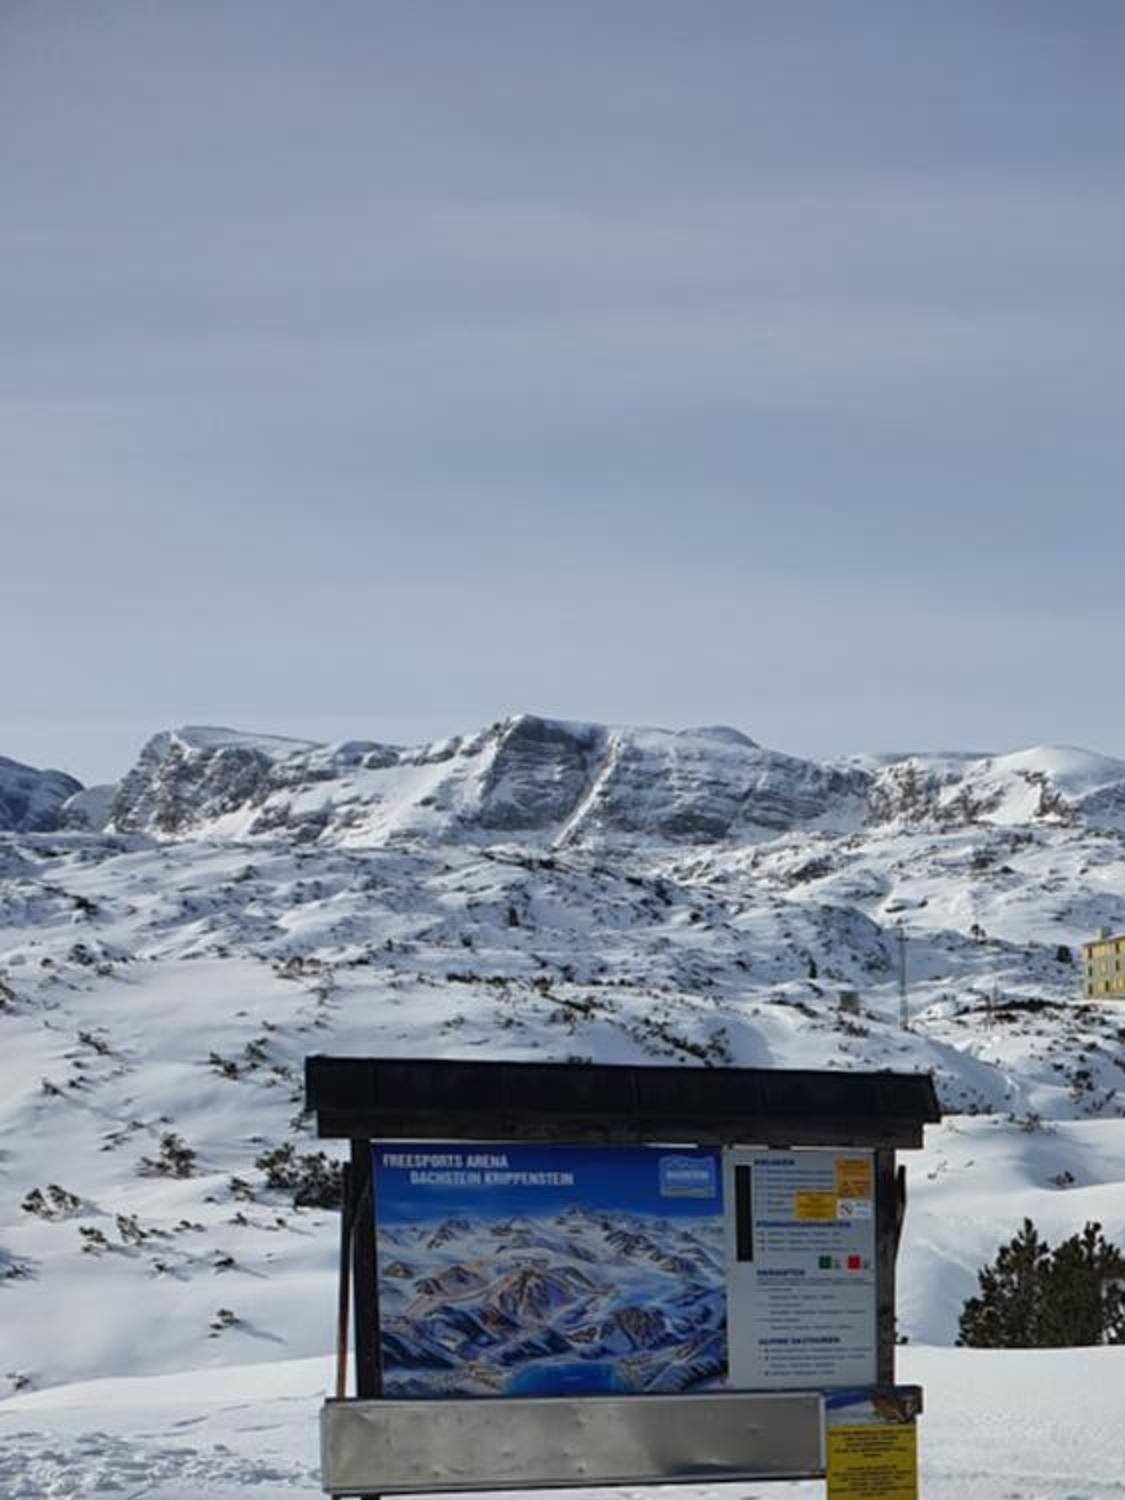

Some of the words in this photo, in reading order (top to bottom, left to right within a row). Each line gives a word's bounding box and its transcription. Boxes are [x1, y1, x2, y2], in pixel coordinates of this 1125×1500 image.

[383, 1153, 463, 1168] FREESPORTS
[466, 1154, 509, 1168] ARENA
[410, 1170, 481, 1185] DACHSTEIN
[484, 1171, 575, 1185] KRIPPENSTEIN
